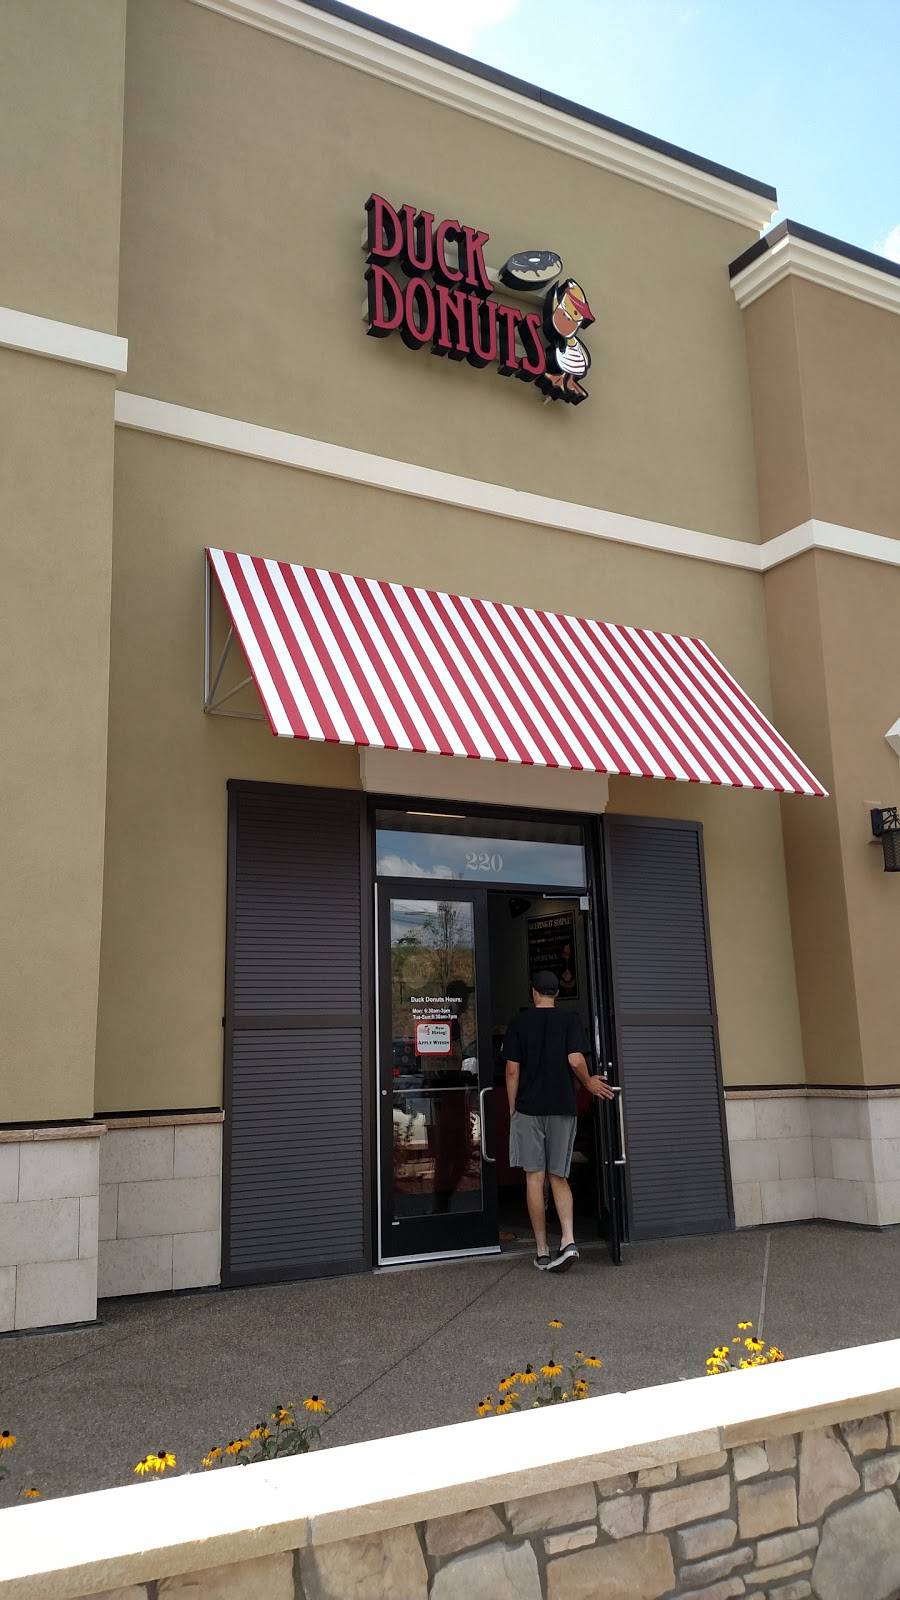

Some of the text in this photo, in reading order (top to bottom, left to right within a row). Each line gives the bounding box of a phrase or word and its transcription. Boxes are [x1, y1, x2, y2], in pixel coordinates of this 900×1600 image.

[369, 193, 494, 292] DUCK
[369, 264, 547, 376] DONUTS
[465, 852, 503, 871] 220
